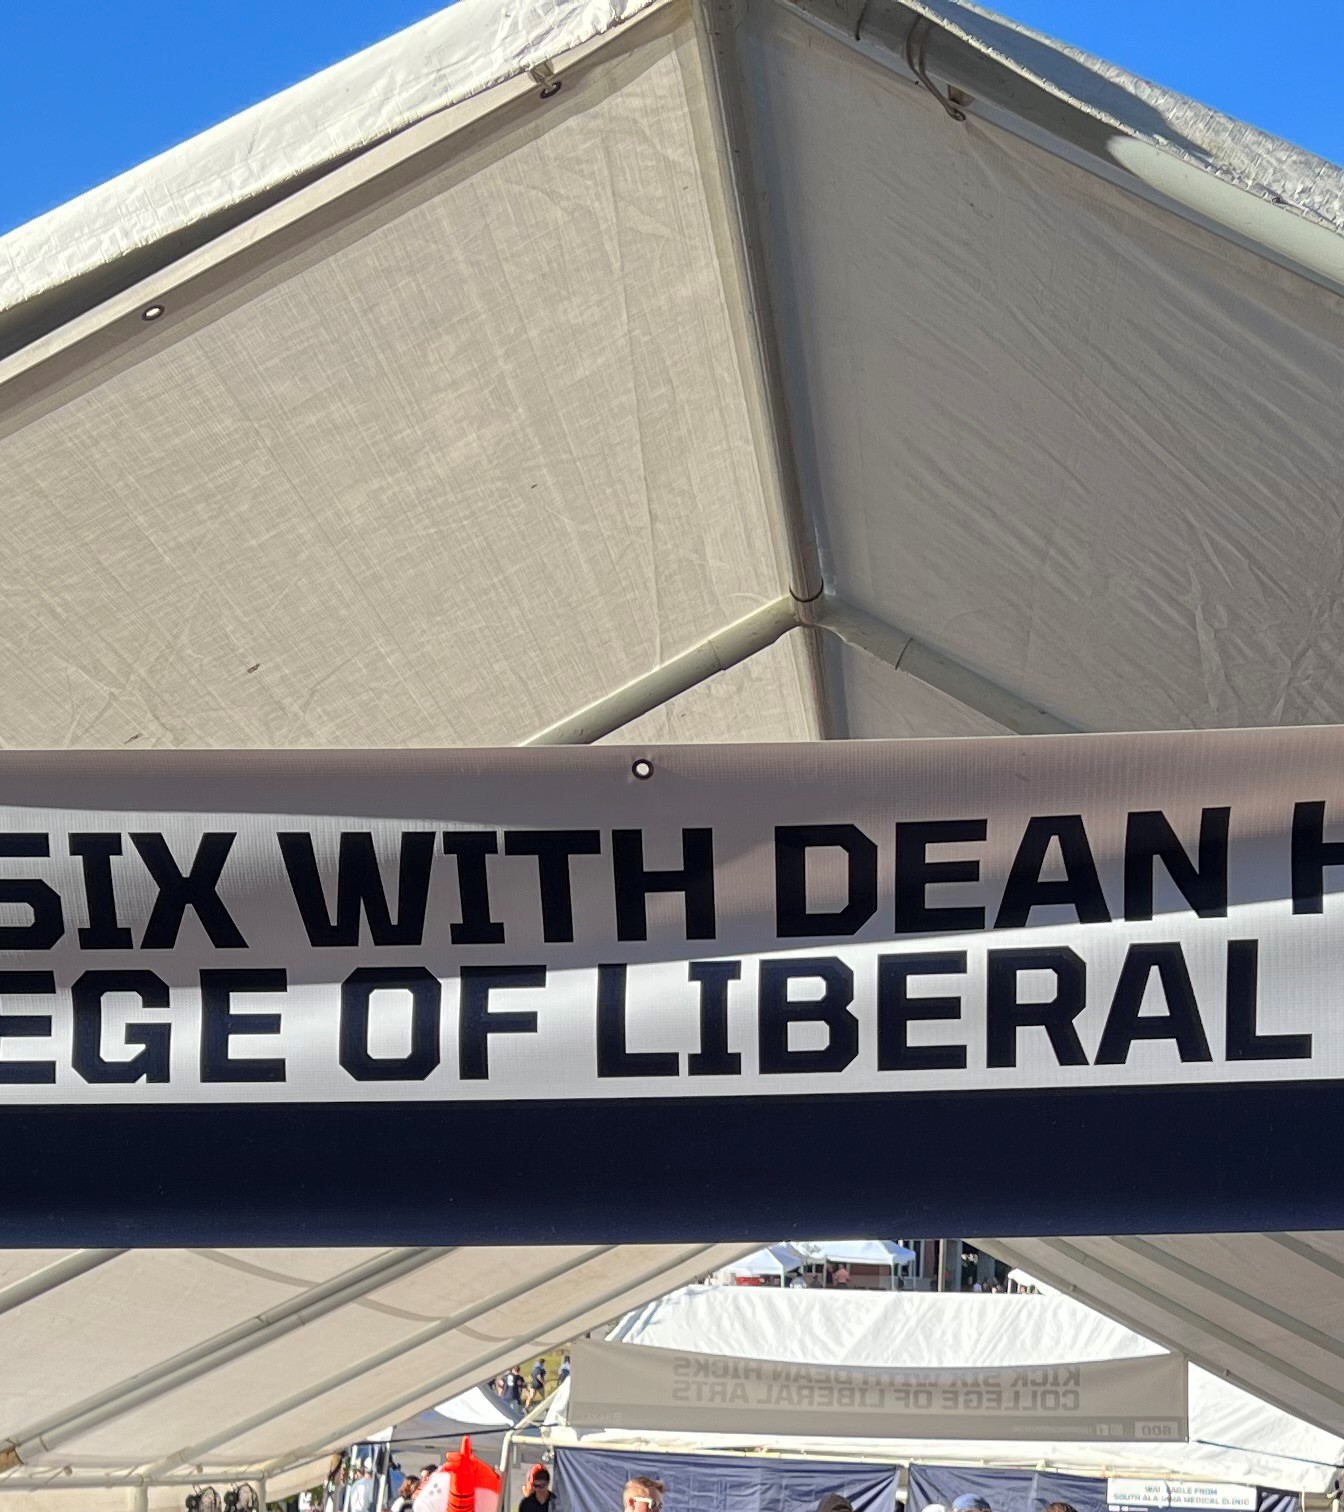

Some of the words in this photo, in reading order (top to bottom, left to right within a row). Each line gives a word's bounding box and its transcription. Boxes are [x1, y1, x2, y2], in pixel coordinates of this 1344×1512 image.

[275, 824, 716, 946] WITH
[775, 803, 1233, 940] DEAN
[337, 961, 549, 1083] OF
[595, 935, 1314, 1079] LIBERAL
